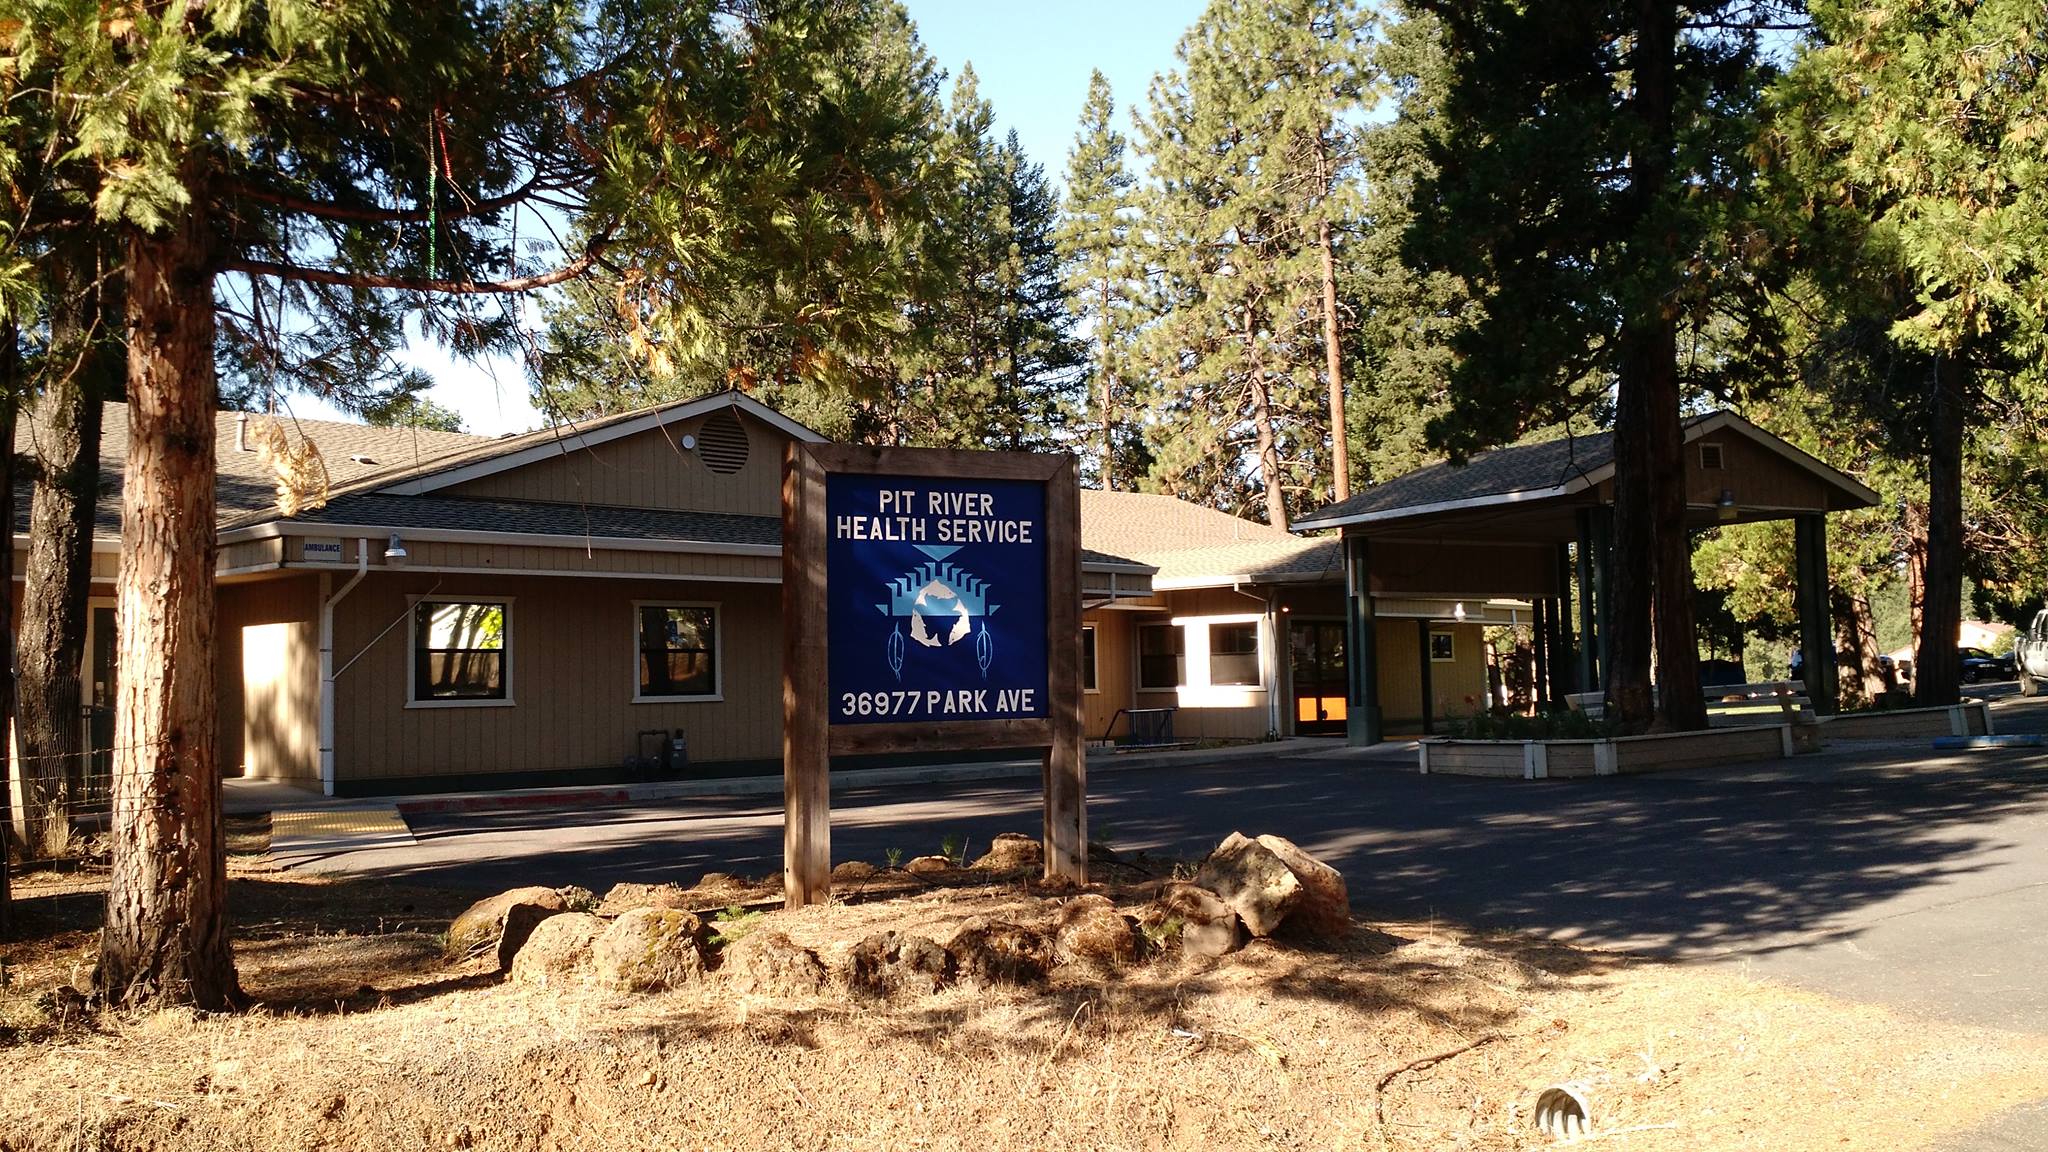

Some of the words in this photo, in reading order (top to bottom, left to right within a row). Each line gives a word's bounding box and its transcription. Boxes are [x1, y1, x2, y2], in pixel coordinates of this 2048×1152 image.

[879, 490, 915, 514] PIT
[929, 492, 994, 516] RIVER
[837, 515, 926, 541] HEALTH
[938, 519, 1032, 543] SERVICE
[304, 543, 341, 552] AMBULANCE
[842, 691, 921, 716] 36977
[927, 690, 988, 714] PARK
[996, 689, 1035, 712] AVE
